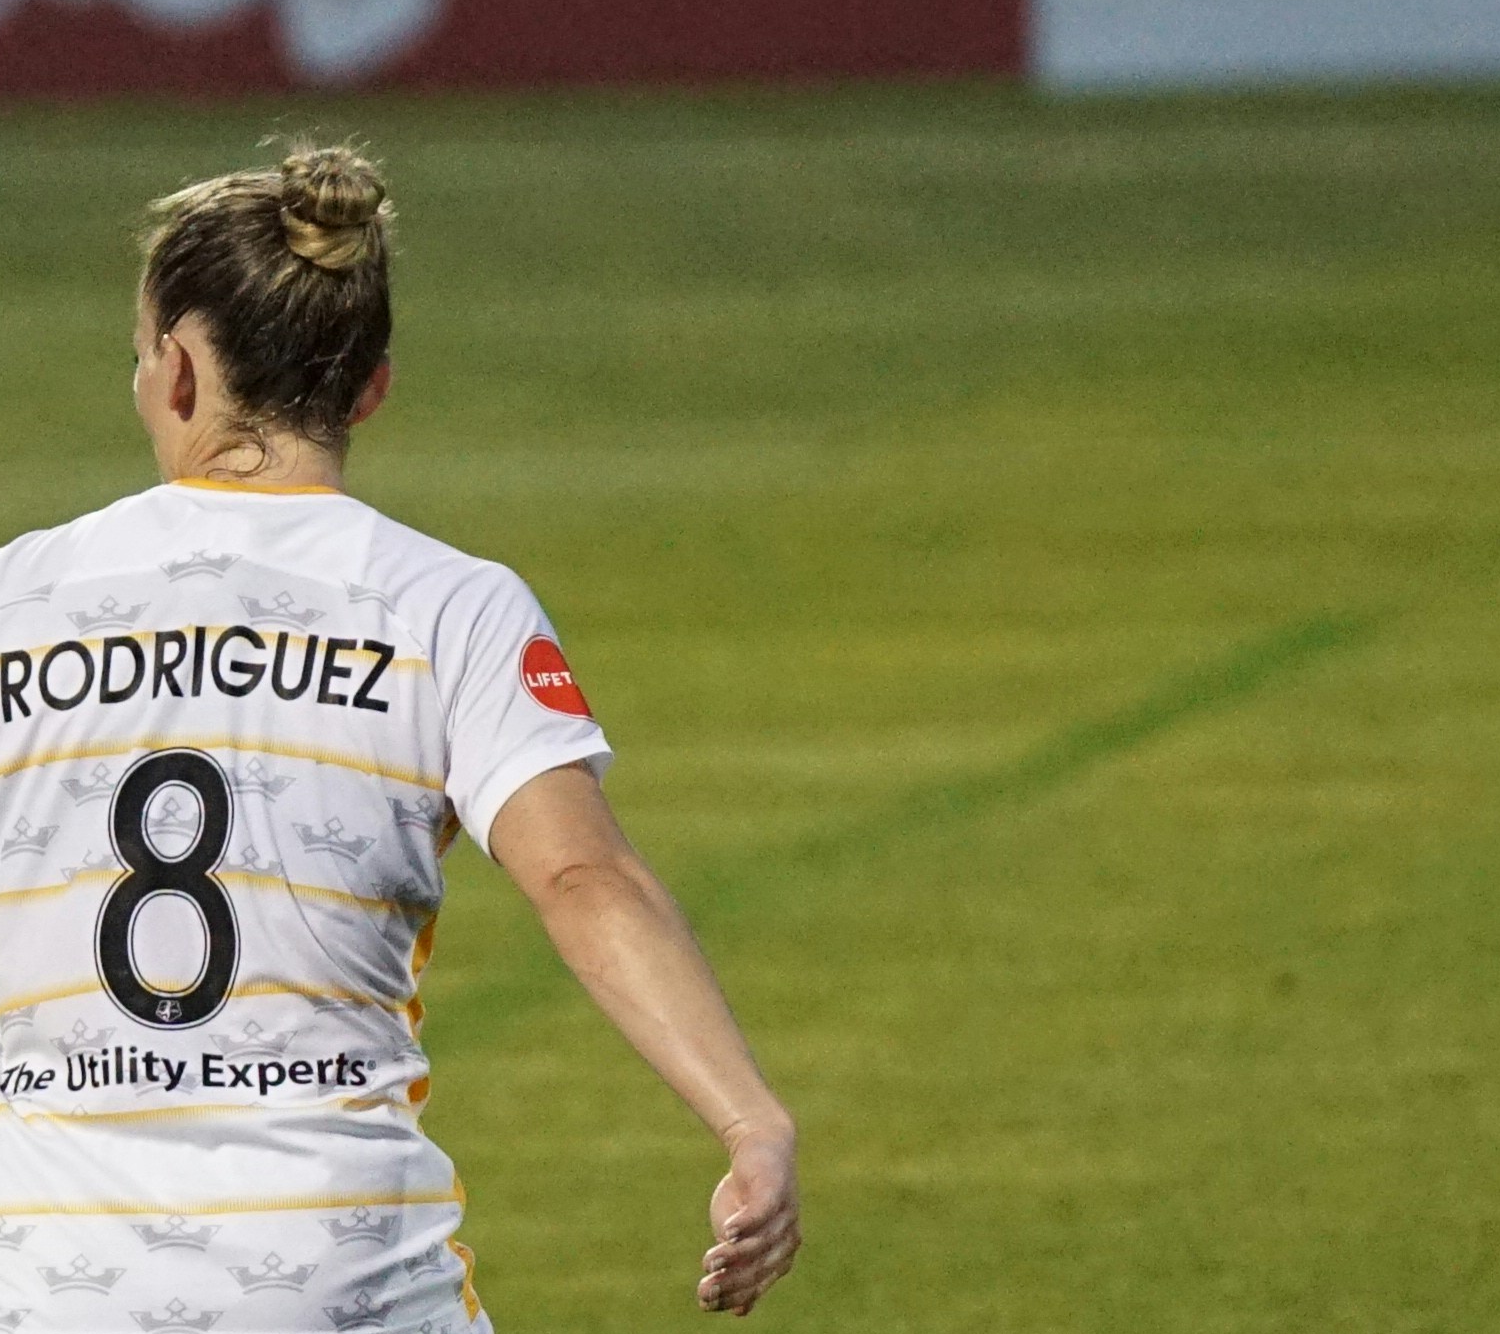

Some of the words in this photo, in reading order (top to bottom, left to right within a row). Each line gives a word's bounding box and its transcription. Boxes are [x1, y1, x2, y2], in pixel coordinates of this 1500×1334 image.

[0, 625, 396, 723] RODRIGUEZ
[526, 671, 573, 688] LIFET
[94, 746, 241, 1031] 8
[0, 1061, 56, 1094] The
[65, 1046, 188, 1092] Utility
[201, 1051, 368, 1096] Experts
